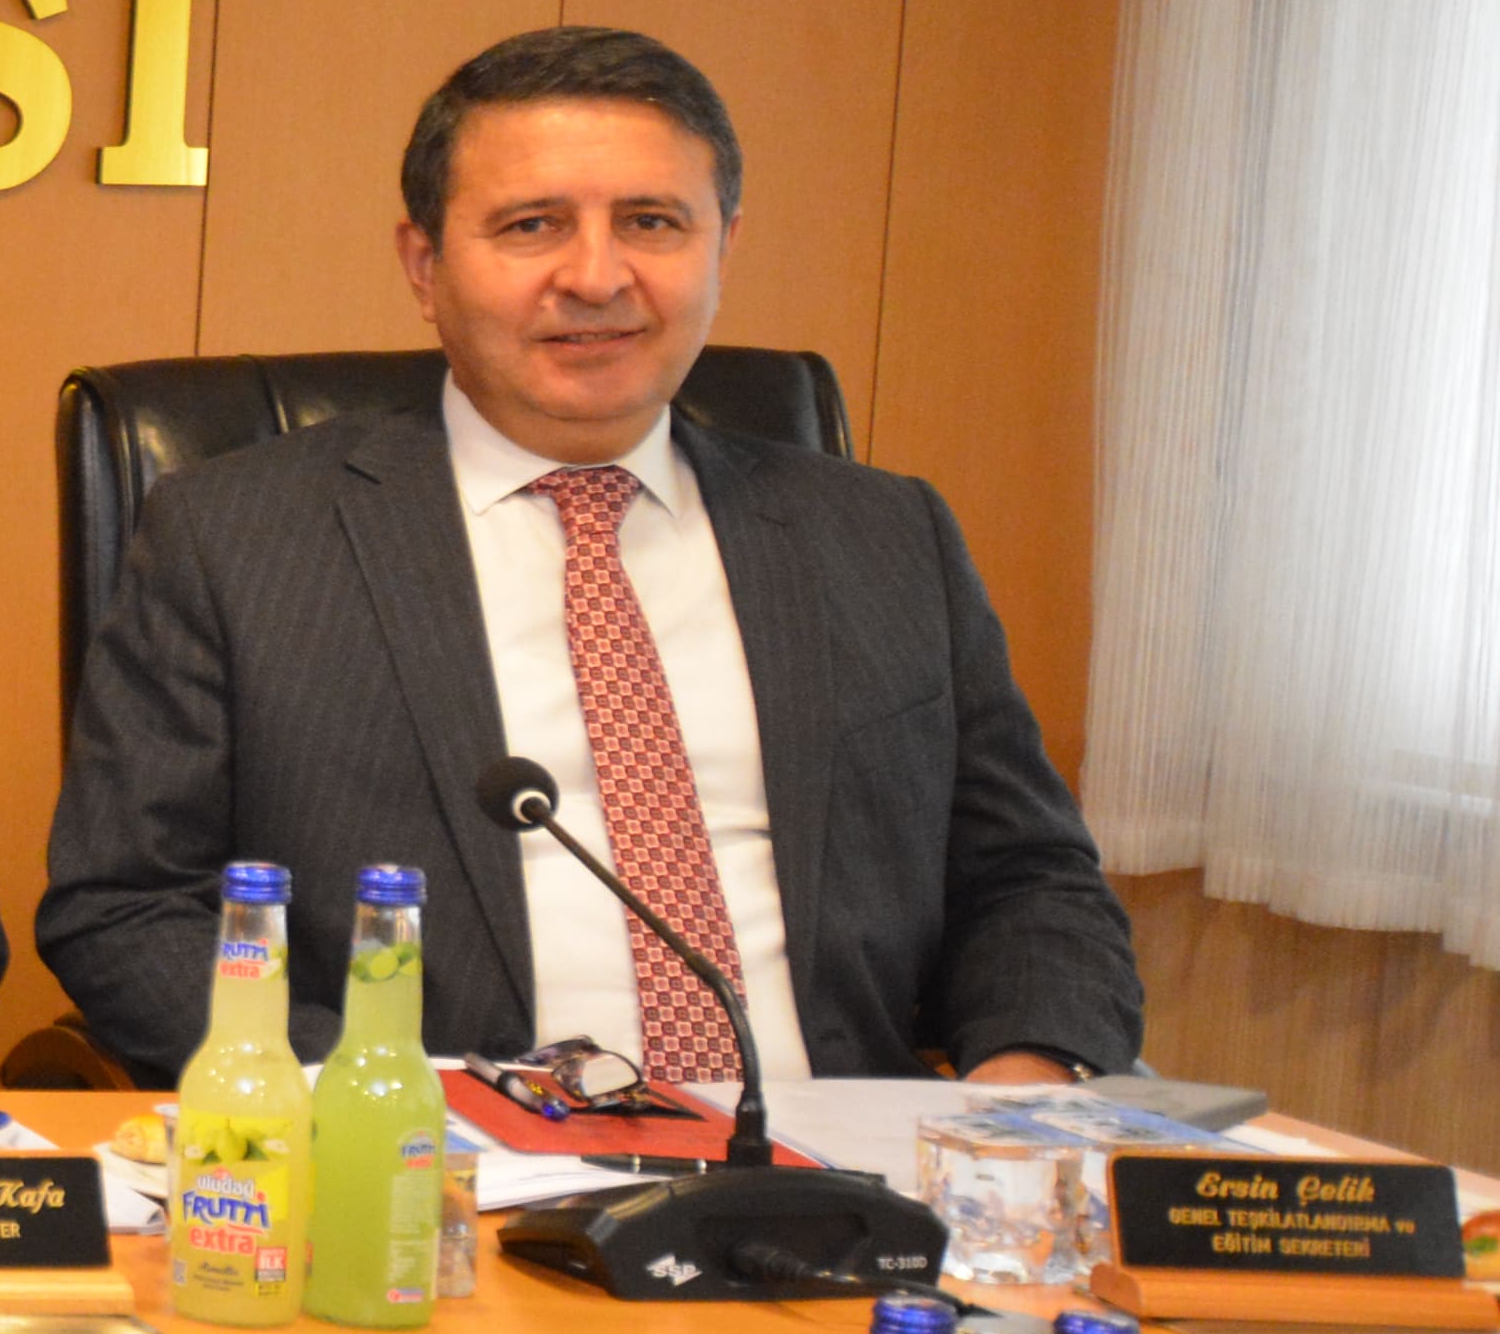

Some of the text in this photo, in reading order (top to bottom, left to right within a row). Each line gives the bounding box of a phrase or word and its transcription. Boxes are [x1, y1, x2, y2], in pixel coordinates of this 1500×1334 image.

[1196, 1172, 1376, 1207] Ersin Çelik
[1168, 1207, 1222, 1227] GENEL
[189, 1226, 256, 1255] extra
